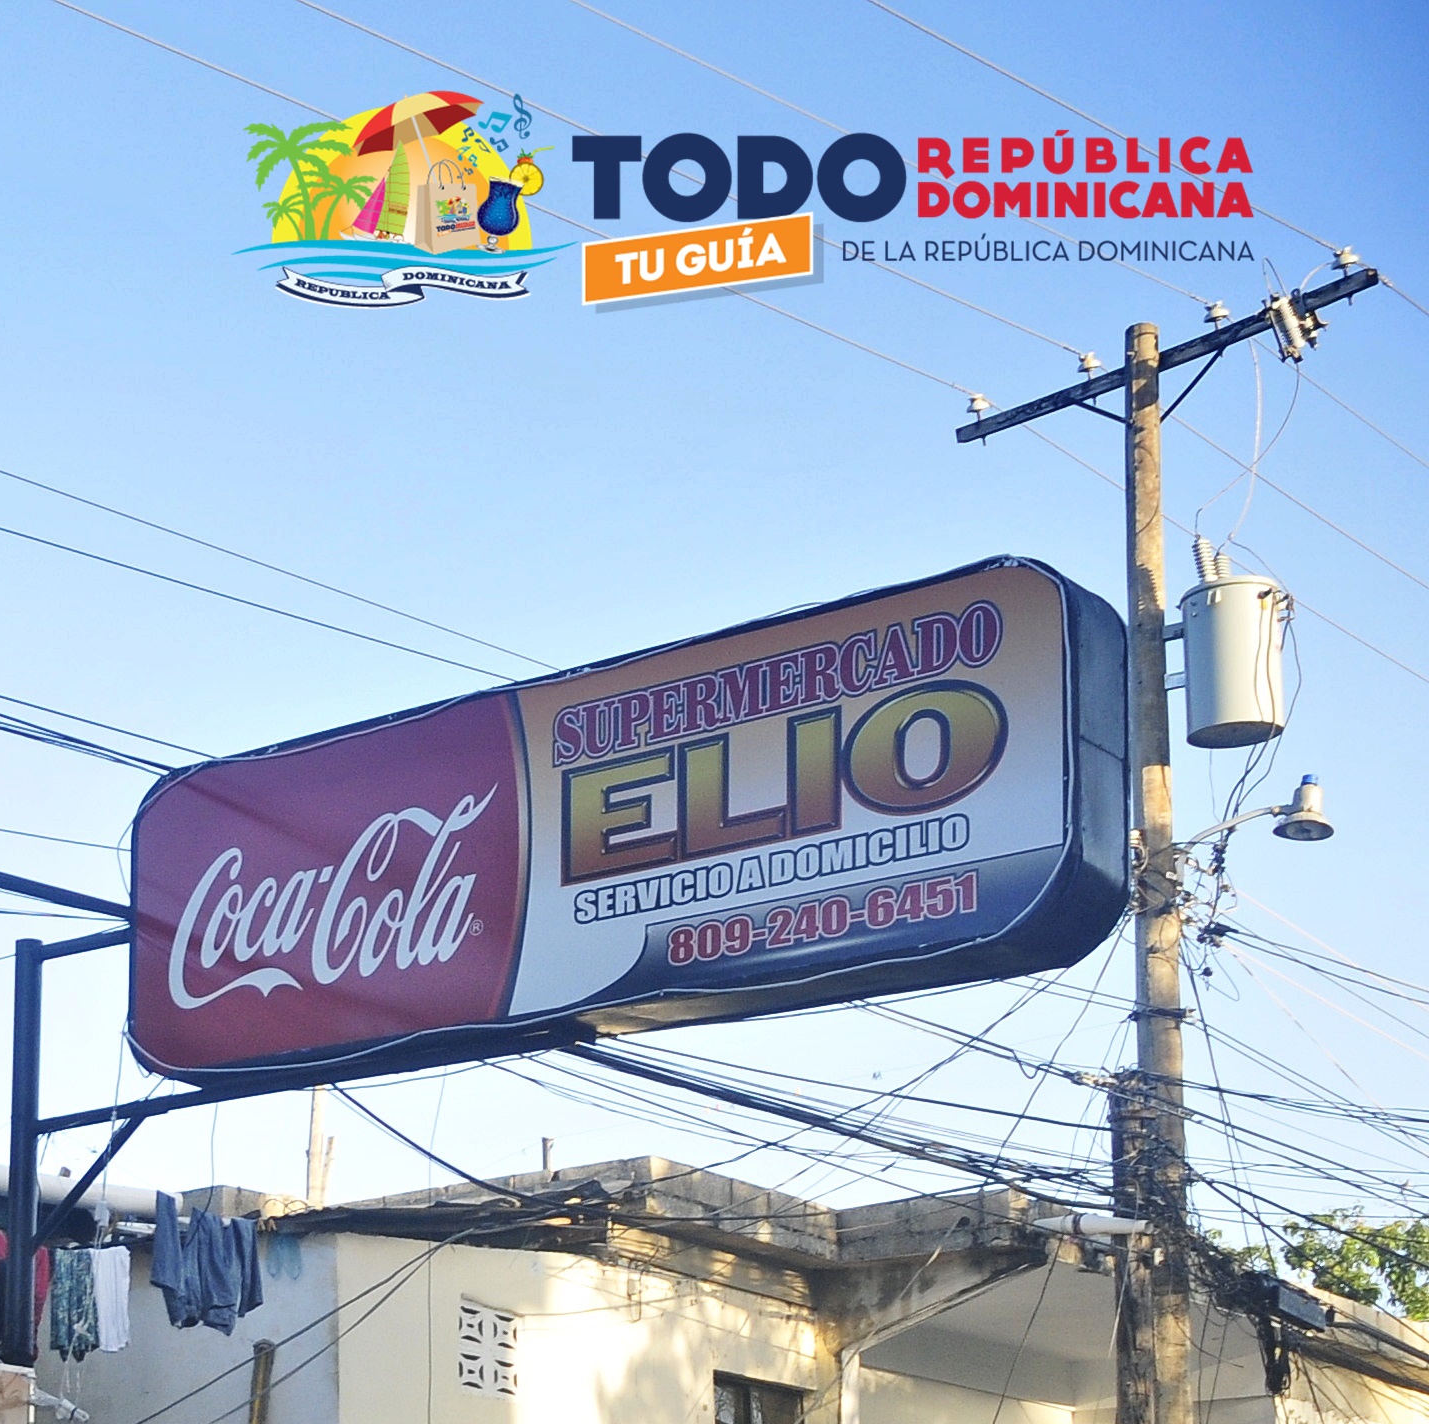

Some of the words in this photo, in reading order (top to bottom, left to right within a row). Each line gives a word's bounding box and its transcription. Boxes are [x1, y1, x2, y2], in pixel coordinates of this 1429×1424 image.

[552, 600, 1002, 766] SUPERMERCADO
[560, 678, 1009, 886] ELIO
[168, 782, 498, 1010] Coca-Cola
[574, 862, 733, 925] SERVICIO
[737, 855, 767, 894] A
[769, 813, 971, 887] DOMICILIO
[667, 868, 981, 967] 809-240-6451
